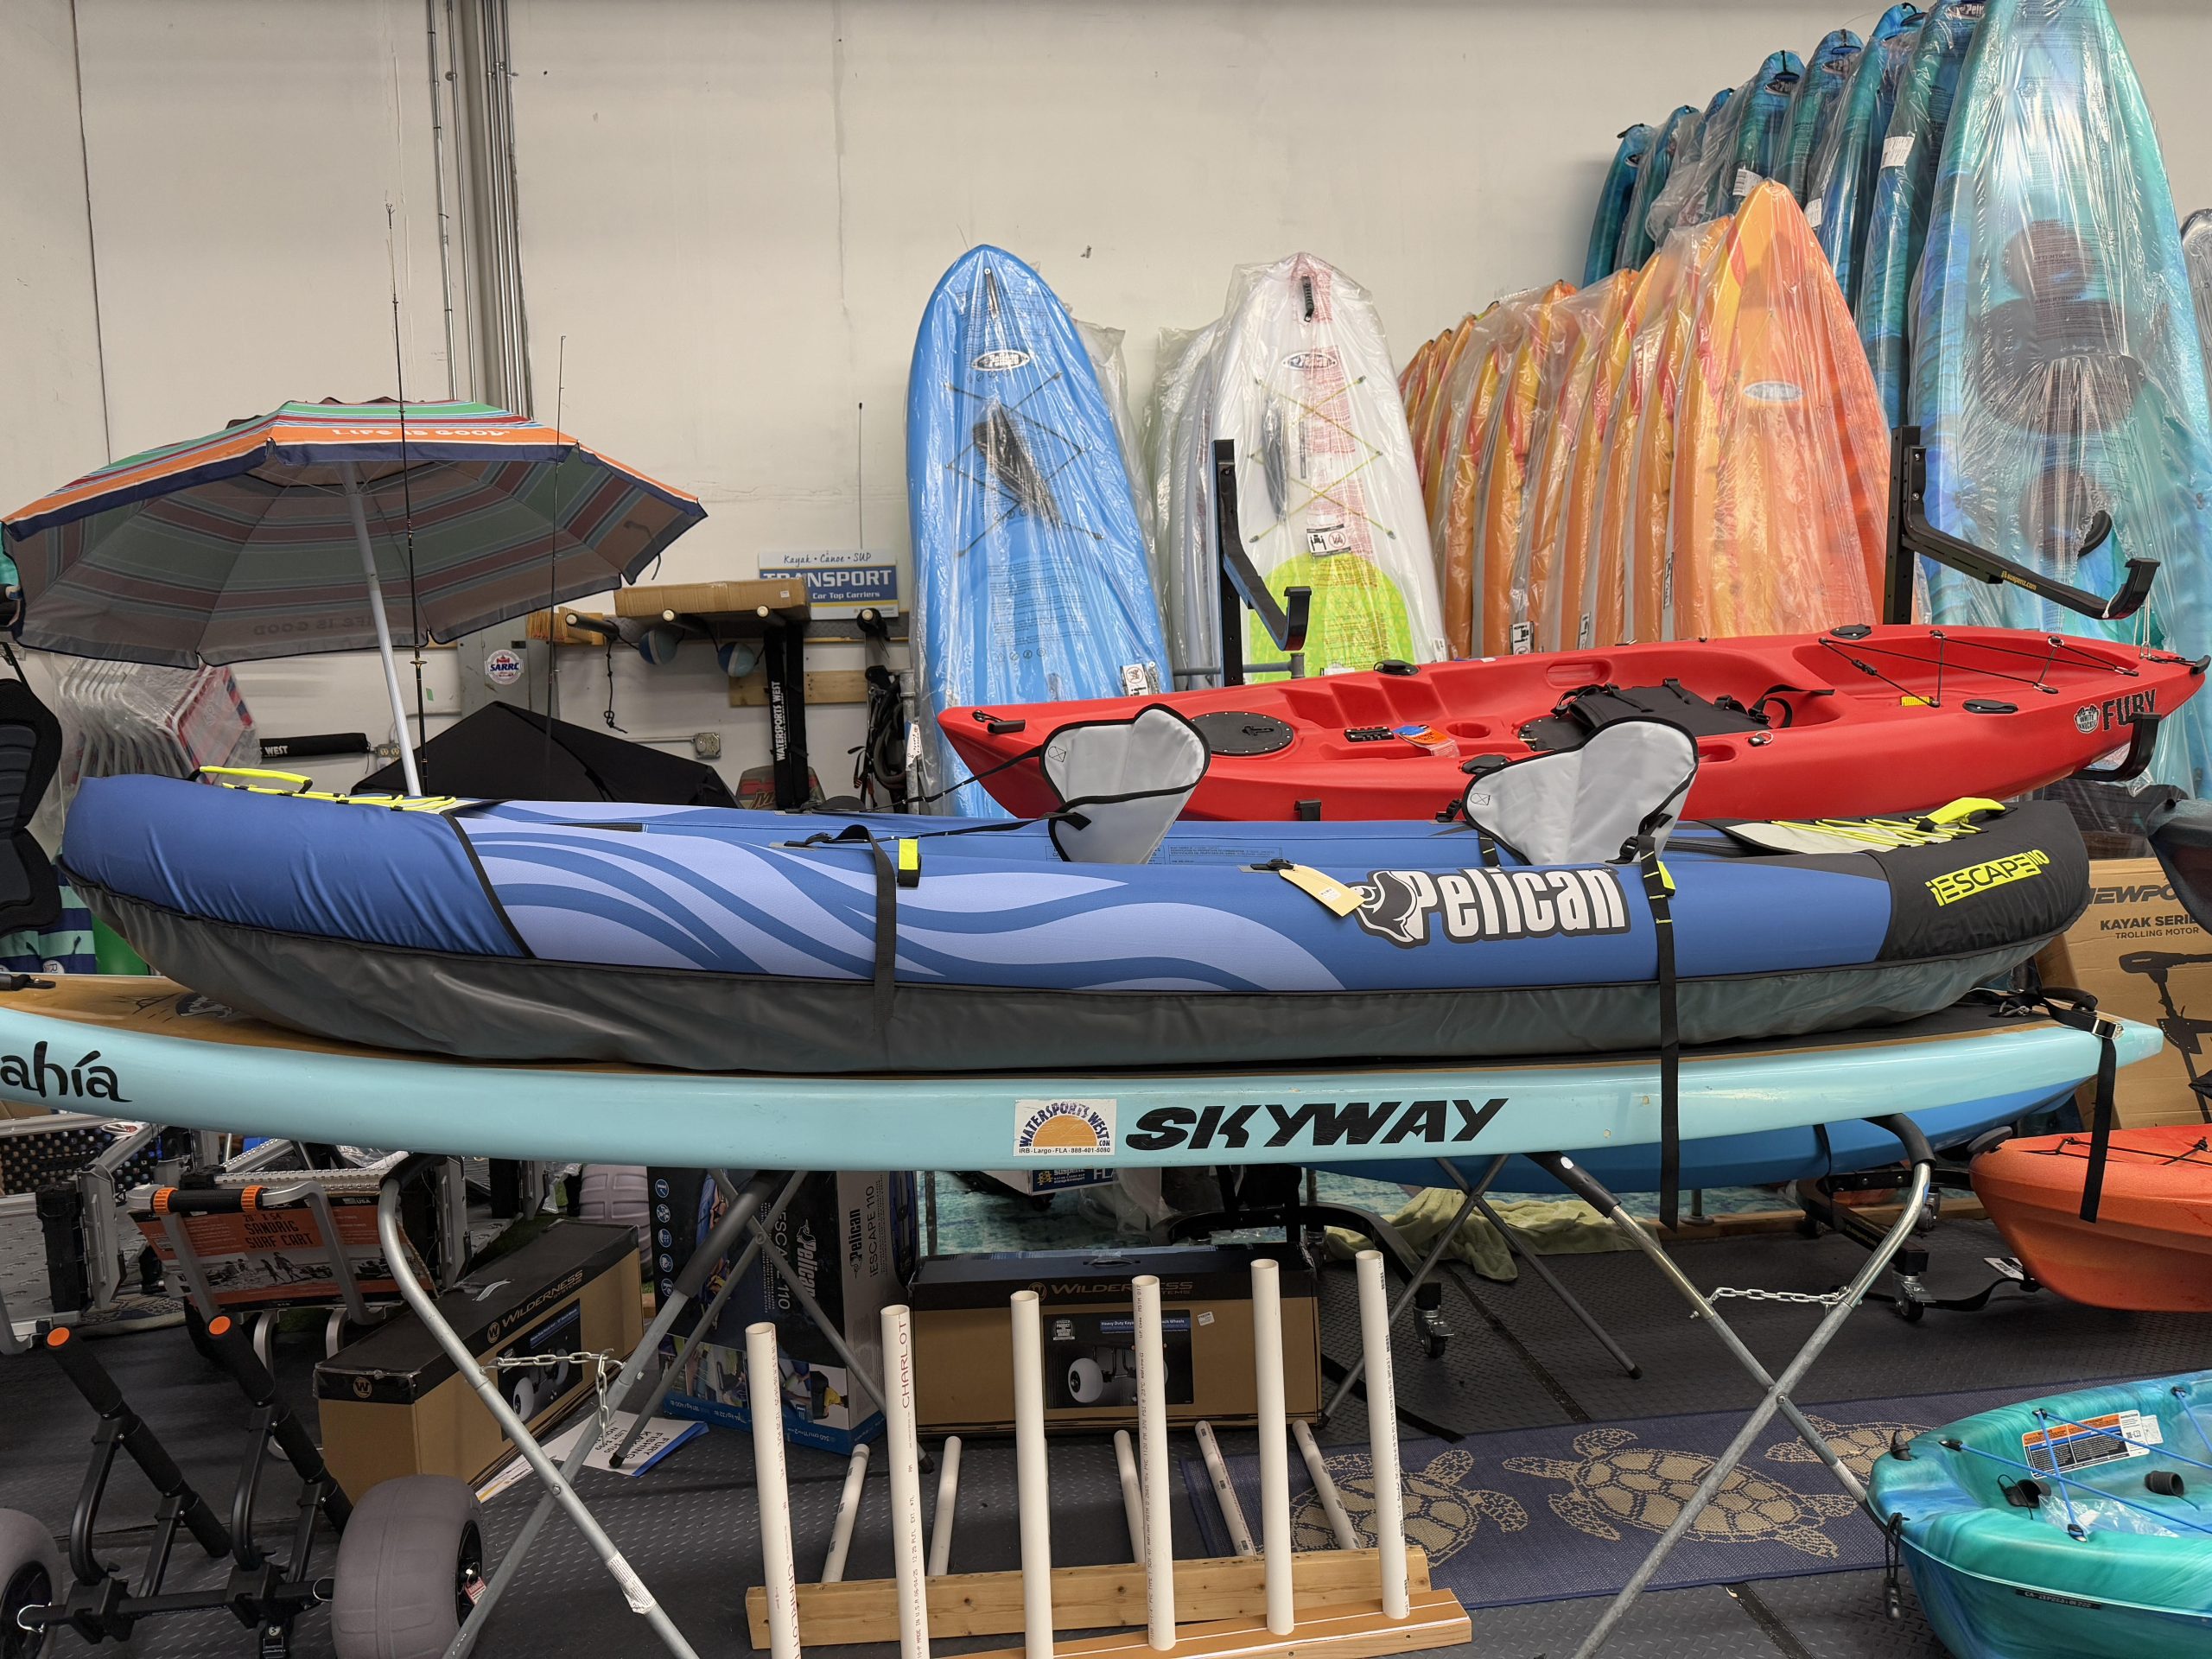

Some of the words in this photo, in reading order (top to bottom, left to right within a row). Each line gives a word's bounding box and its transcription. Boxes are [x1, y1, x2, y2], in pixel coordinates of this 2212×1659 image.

[784, 555, 811, 568] Kayak
[820, 554, 845, 563] Canoe
[854, 552, 872, 563] SUP
[830, 592, 844, 601] Top
[490, 662, 520, 672] SARRC
[772, 681, 781, 704] WEST
[2101, 688, 2157, 732] FURY
[772, 704, 785, 762] WATERSPORTS
[264, 745, 289, 755] WEST
[1390, 867, 1626, 941] Pelican
[2100, 917, 2152, 931] KAYAK
[2115, 930, 2163, 939] TROLLING
[2165, 926, 2200, 937] MOTOR
[1019, 1101, 1090, 1147] WATERSPORTS
[1087, 1111, 1110, 1139] WEST
[1125, 1098, 1510, 1151] SKYWAY
[865, 1185, 875, 1209] 110
[244, 1220, 300, 1236] SANDRIG
[849, 1208, 863, 1260] Pelican
[245, 1236, 277, 1249] SURF
[282, 1232, 315, 1247] CART
[867, 1211, 879, 1278] iESCAPE
[501, 1268, 584, 1328] WILDERNESS
[778, 1285, 791, 1310] 110
[1051, 1281, 1193, 1294] WILDERSS
[898, 1314, 910, 1408] CHARLOT
[626, 1431, 664, 1459] FISHING
[648, 1437, 670, 1456] FURY
